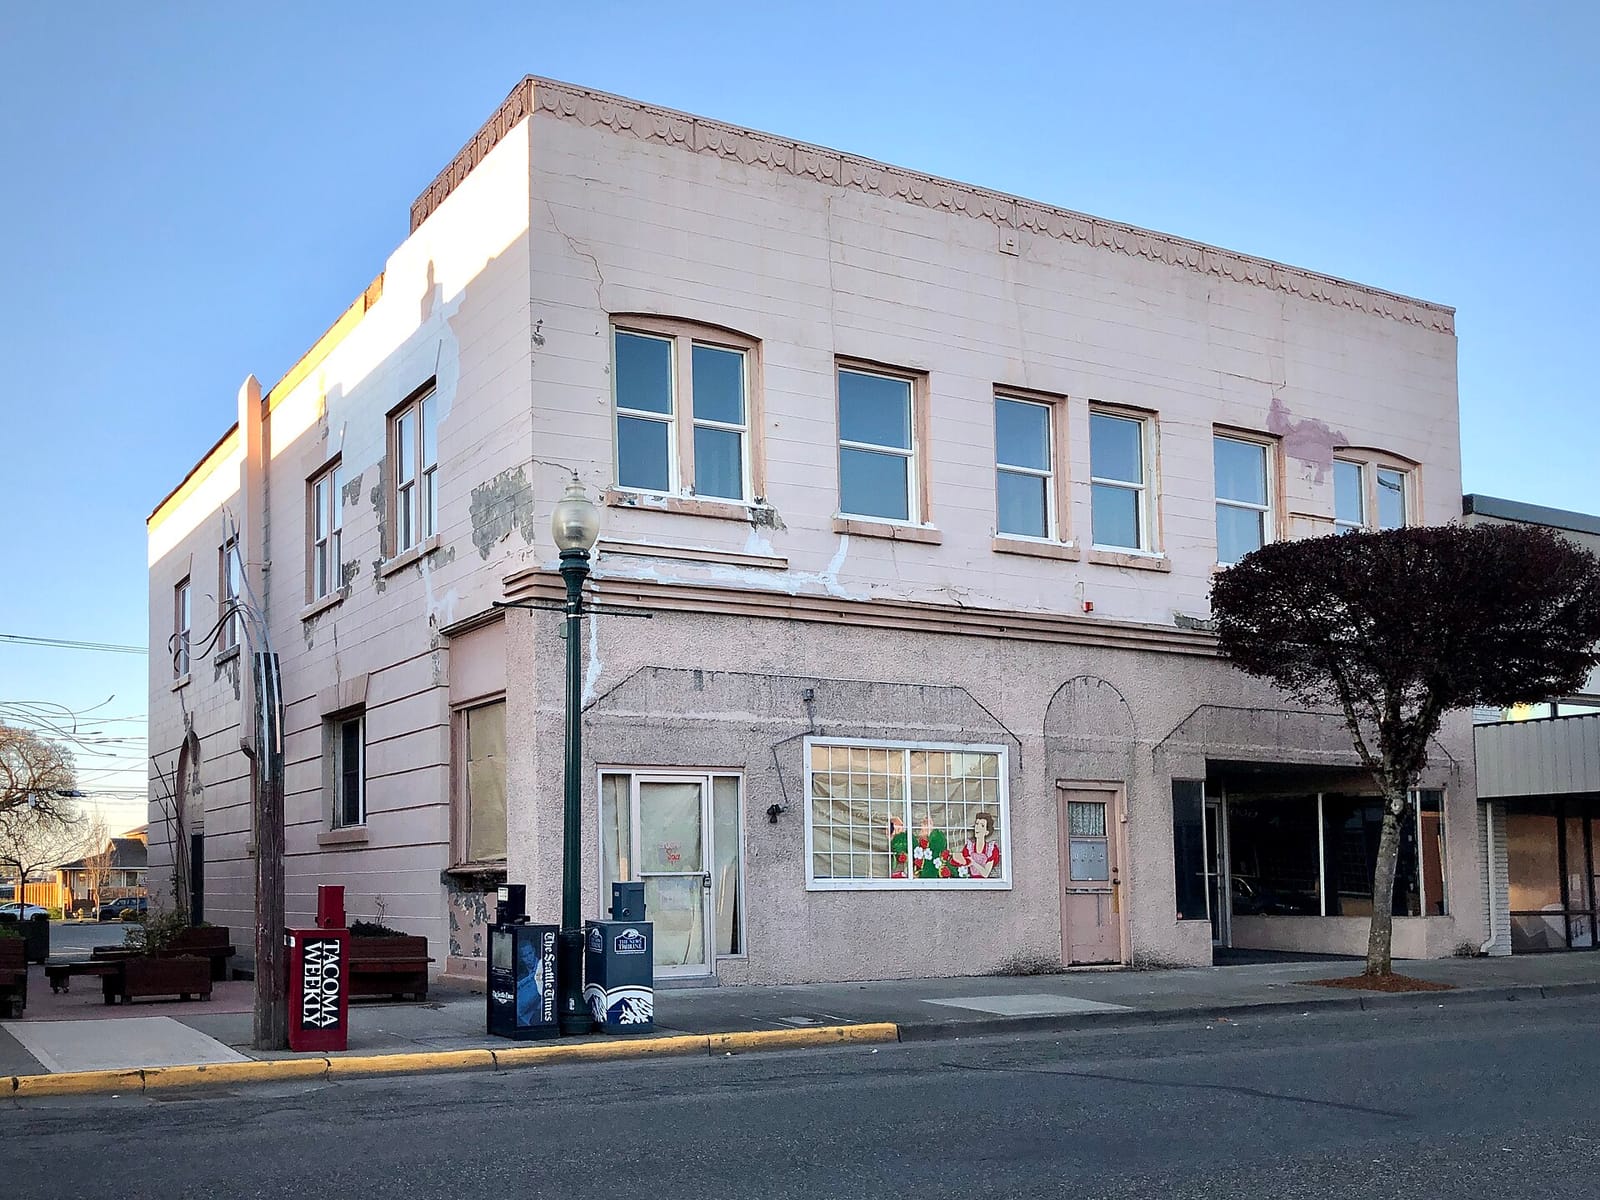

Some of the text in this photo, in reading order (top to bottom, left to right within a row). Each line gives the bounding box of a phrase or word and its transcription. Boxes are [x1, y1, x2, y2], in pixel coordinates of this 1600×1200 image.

[303, 941, 322, 1027] WEEKLY
[321, 939, 340, 1028] TACOMA
[544, 932, 555, 1021] The Seattle Times
